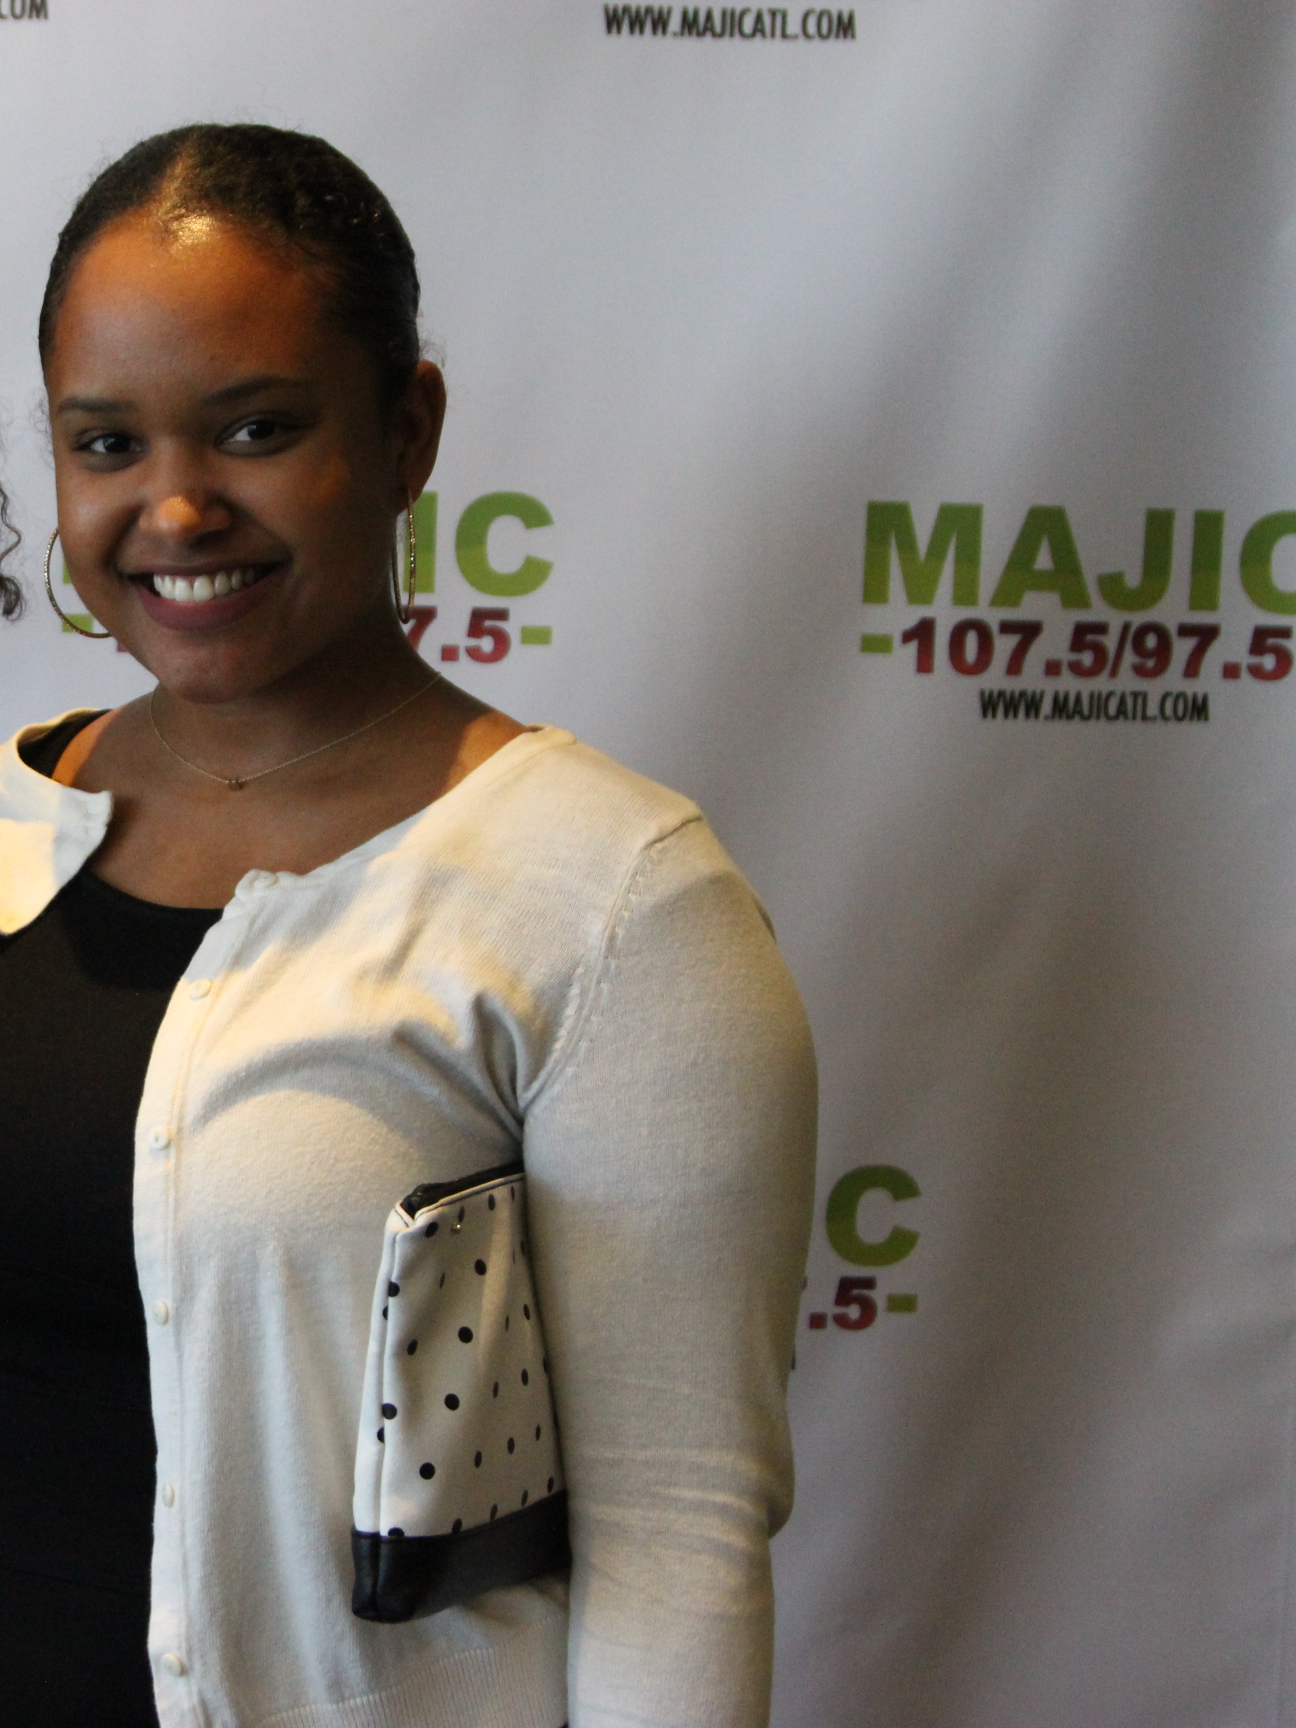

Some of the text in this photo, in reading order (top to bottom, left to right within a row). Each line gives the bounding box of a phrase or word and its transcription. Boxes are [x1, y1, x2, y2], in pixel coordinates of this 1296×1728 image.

[604, 5, 856, 39] WWW.MAJICATL.COM
[862, 501, 1296, 616] MAJIC
[979, 688, 1211, 722] WWW.MAJICATL.COM
